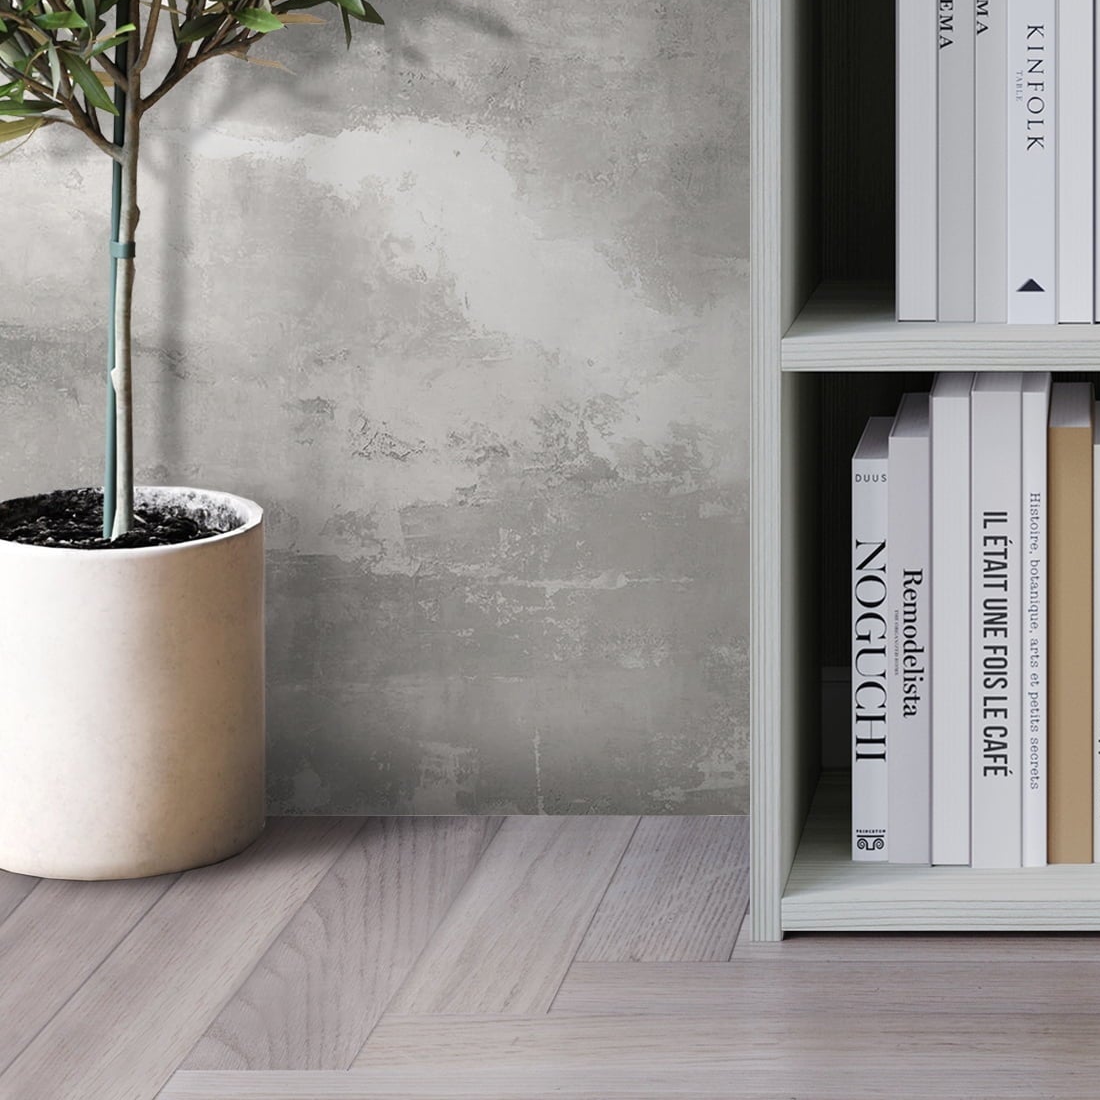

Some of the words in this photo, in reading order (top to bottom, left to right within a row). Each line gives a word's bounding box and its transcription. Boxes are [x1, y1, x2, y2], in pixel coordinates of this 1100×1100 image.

[1026, 25, 1045, 152] KINFOLK
[855, 473, 887, 483] DUUS
[983, 511, 1008, 529] IL
[1028, 492, 1041, 556] Histoire,
[982, 535, 1013, 591] ÉTAIT
[982, 597, 1008, 638] UNE
[1027, 559, 1041, 634] botanique,
[854, 539, 887, 763] NOGUCHI
[902, 568, 924, 718] Remodelista
[982, 645, 1008, 689] FOIS
[1029, 638, 1041, 668] arts
[1029, 673, 1041, 688] et
[982, 695, 1008, 720] LE
[1027, 691, 1041, 732] petits
[982, 725, 1013, 777] CAFÉ
[1029, 737, 1041, 790] secrets
